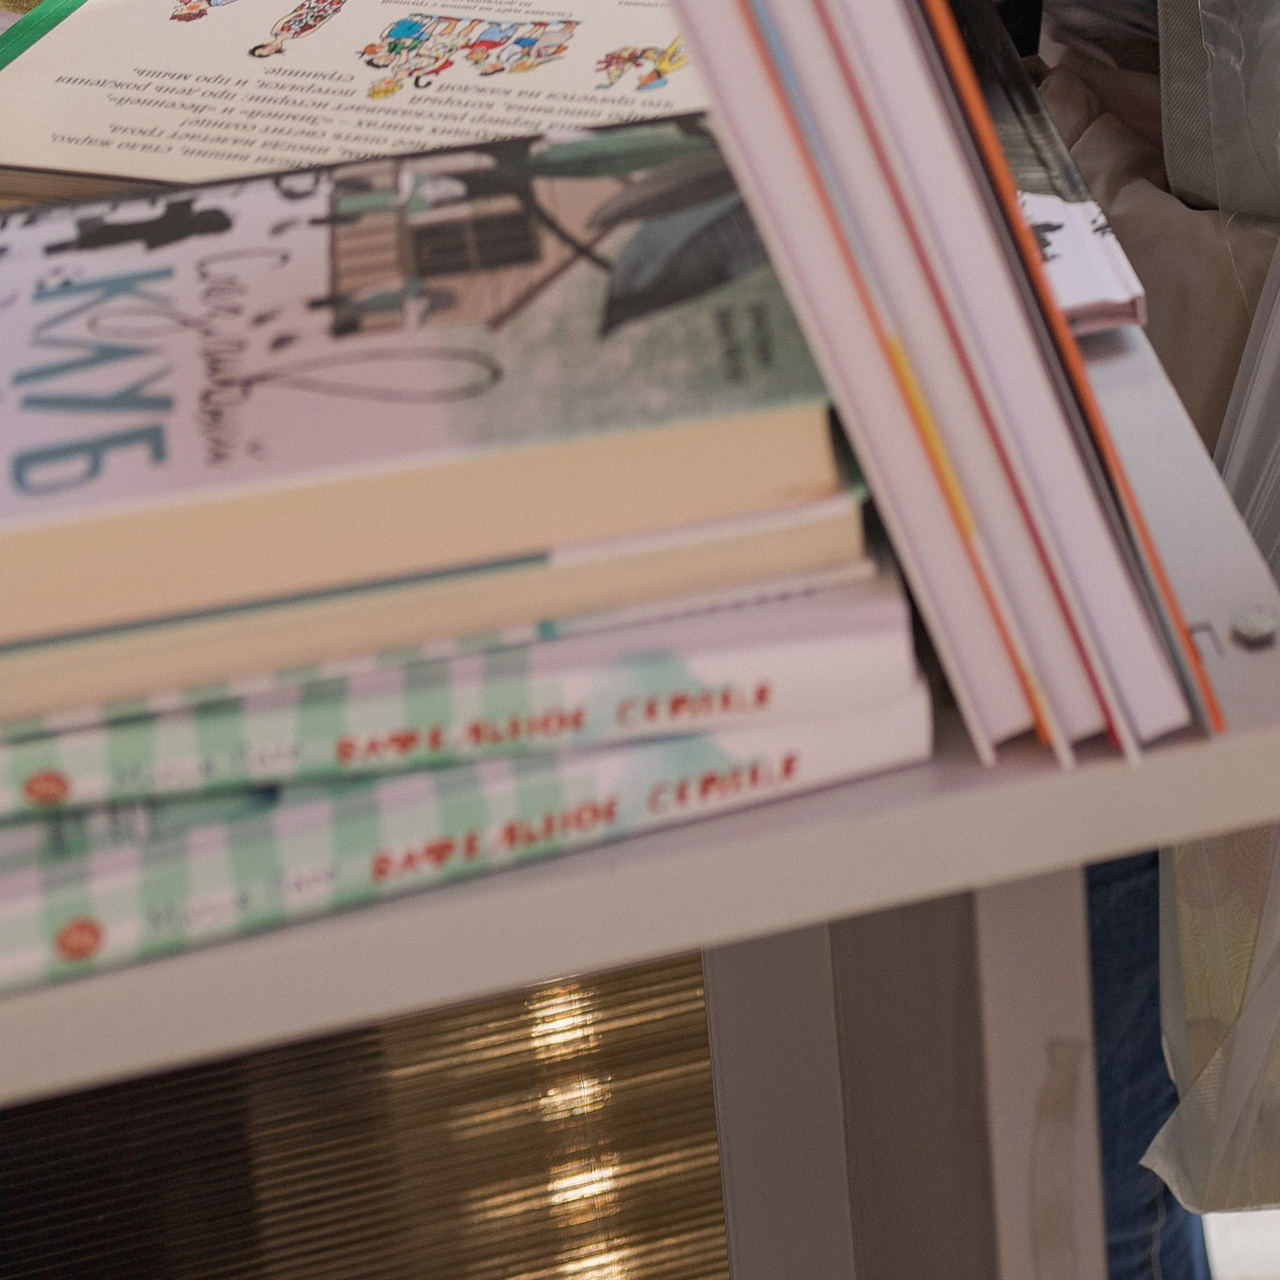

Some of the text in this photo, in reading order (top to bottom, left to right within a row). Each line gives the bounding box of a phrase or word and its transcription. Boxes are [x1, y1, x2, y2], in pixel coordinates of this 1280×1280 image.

[50, 72, 153, 93] рождения
[126, 66, 195, 82] мышь,
[256, 64, 358, 84] странице.
[148, 83, 202, 97] день
[196, 87, 240, 101] про
[250, 77, 359, 99] потерялся,
[101, 121, 169, 139] гроза,
[177, 115, 261, 134] солнце!
[44, 132, 118, 149] жарко,
[113, 140, 175, 155] стало
